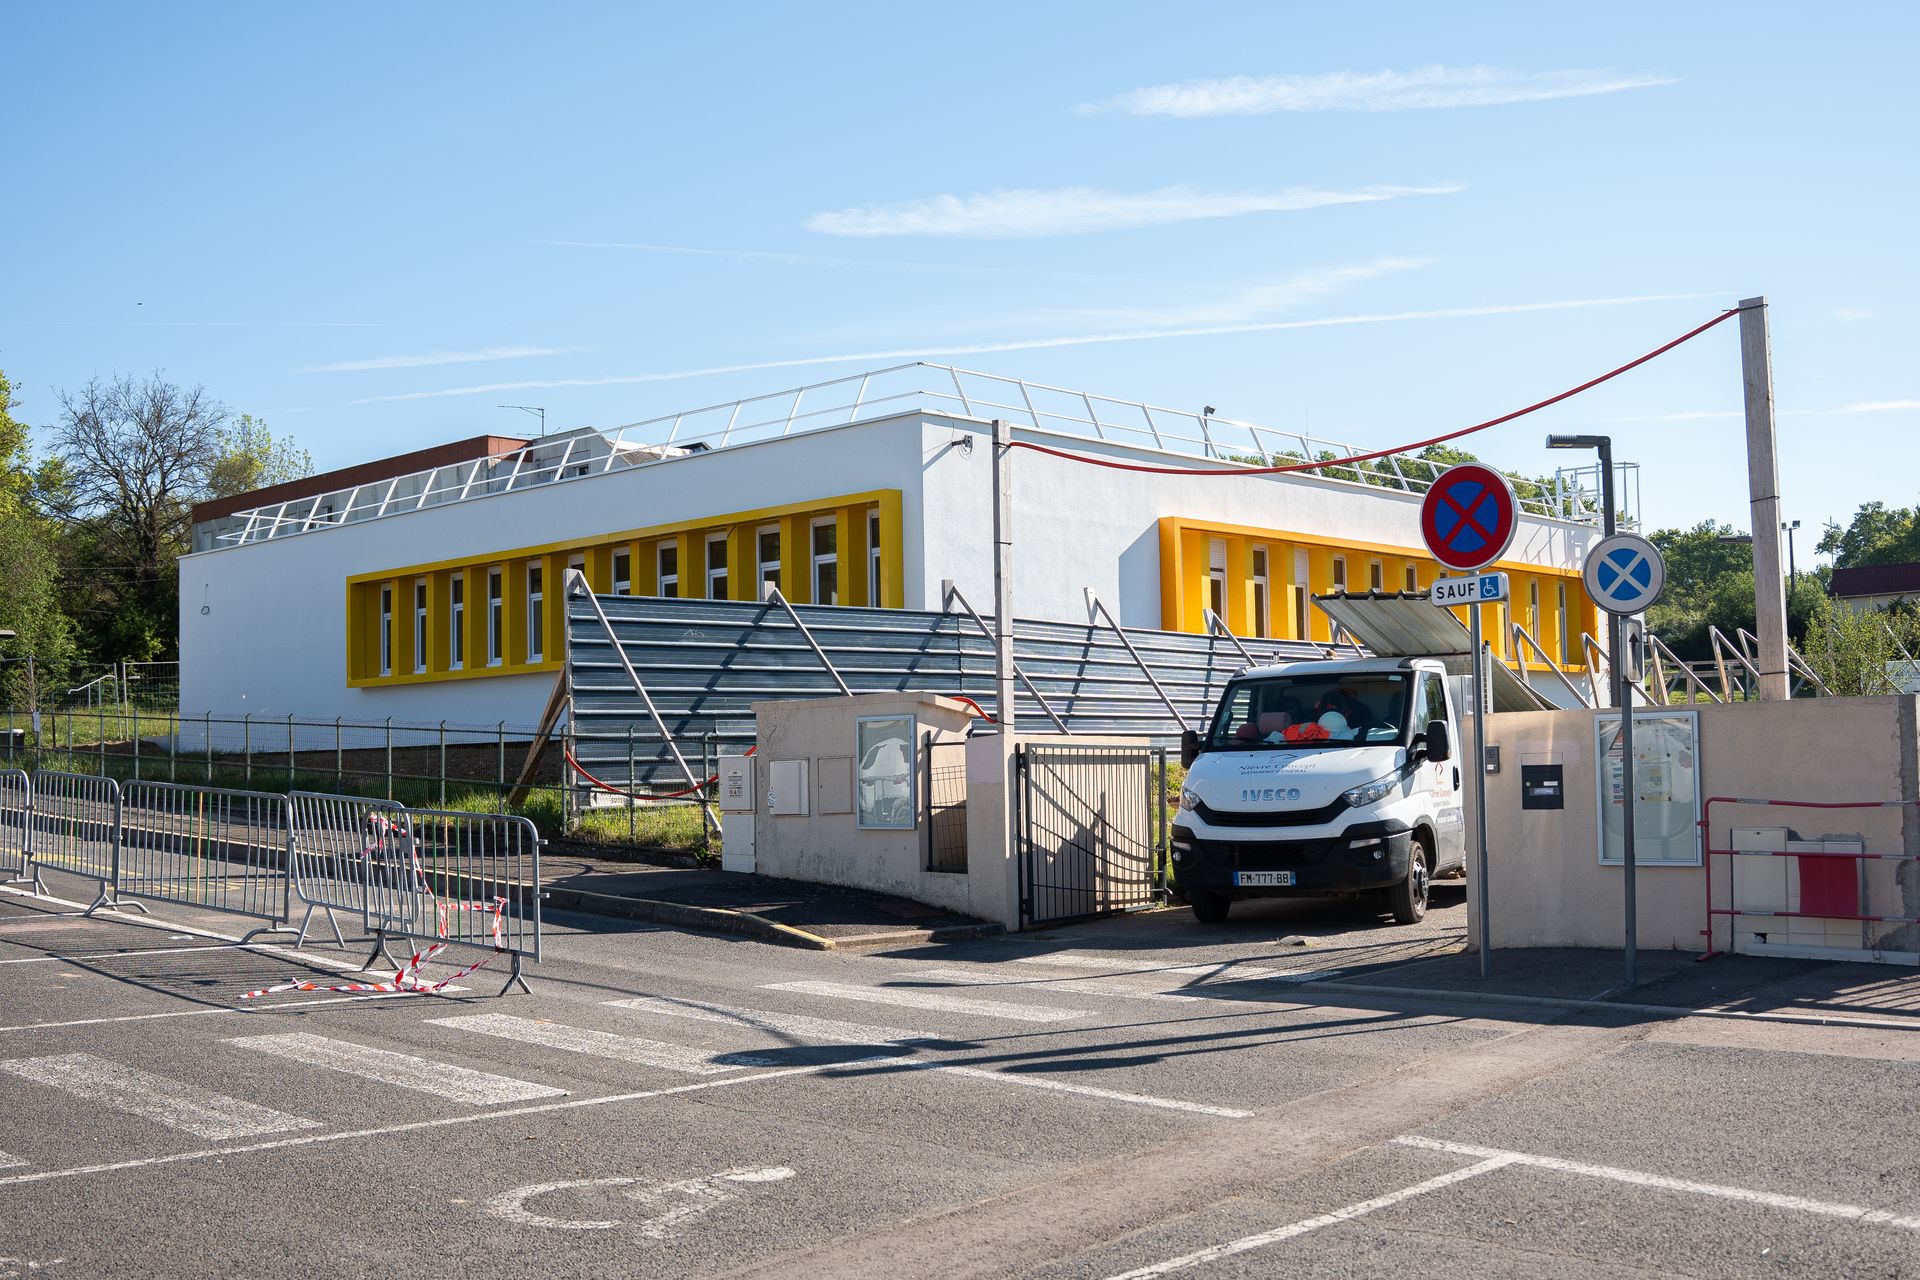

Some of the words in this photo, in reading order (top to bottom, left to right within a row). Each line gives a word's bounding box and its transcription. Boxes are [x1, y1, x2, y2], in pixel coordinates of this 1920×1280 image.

[1436, 582, 1475, 600] SAUF
[1241, 788, 1300, 802] IVECO
[1240, 873, 1289, 884] FM-777-BB
